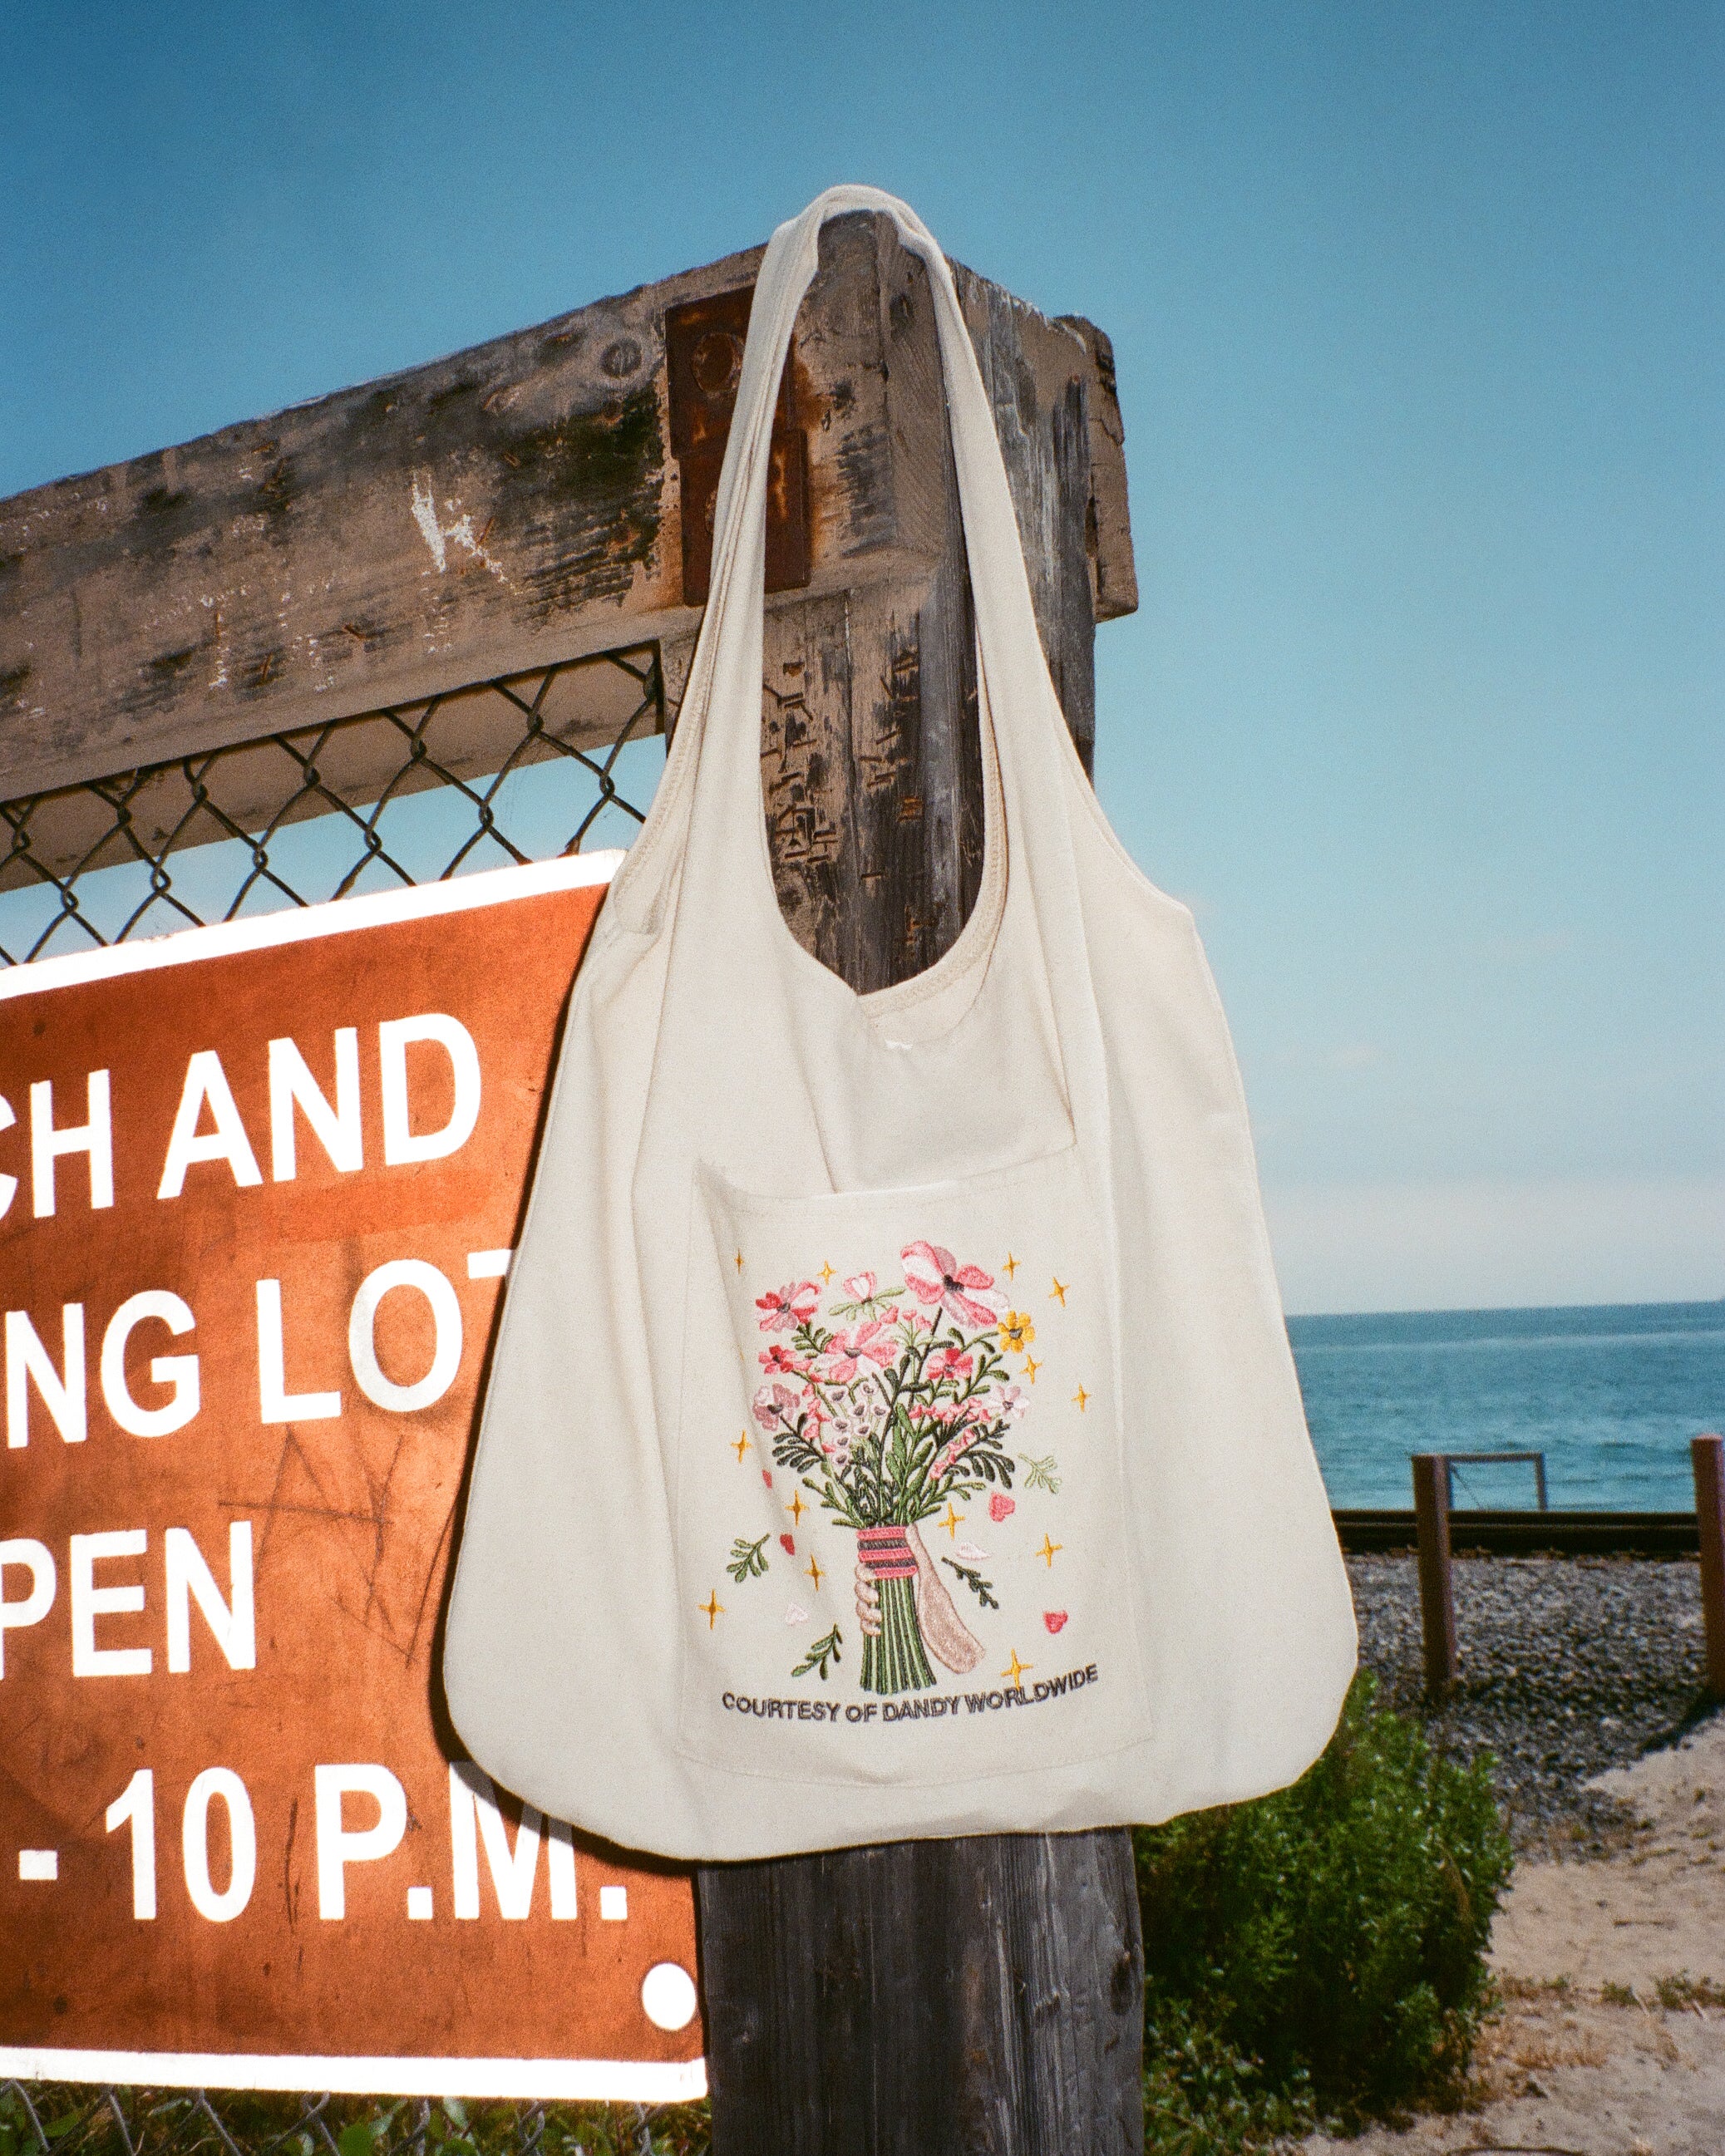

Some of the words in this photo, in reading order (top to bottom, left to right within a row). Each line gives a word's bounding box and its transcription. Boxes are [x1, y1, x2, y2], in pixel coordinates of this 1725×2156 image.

[0, 1069, 114, 1220] H
[157, 1013, 483, 1199] AND
[6, 1290, 201, 1448] NG
[0, 1521, 257, 1681] PEN
[722, 1691, 840, 1722] COURTESY
[845, 1703, 878, 1723] OF
[882, 1695, 963, 1722] DANDY
[964, 1663, 1099, 1714] WORLDWIDE
[106, 1767, 257, 1922] 10
[315, 1761, 628, 1921] P.M.
